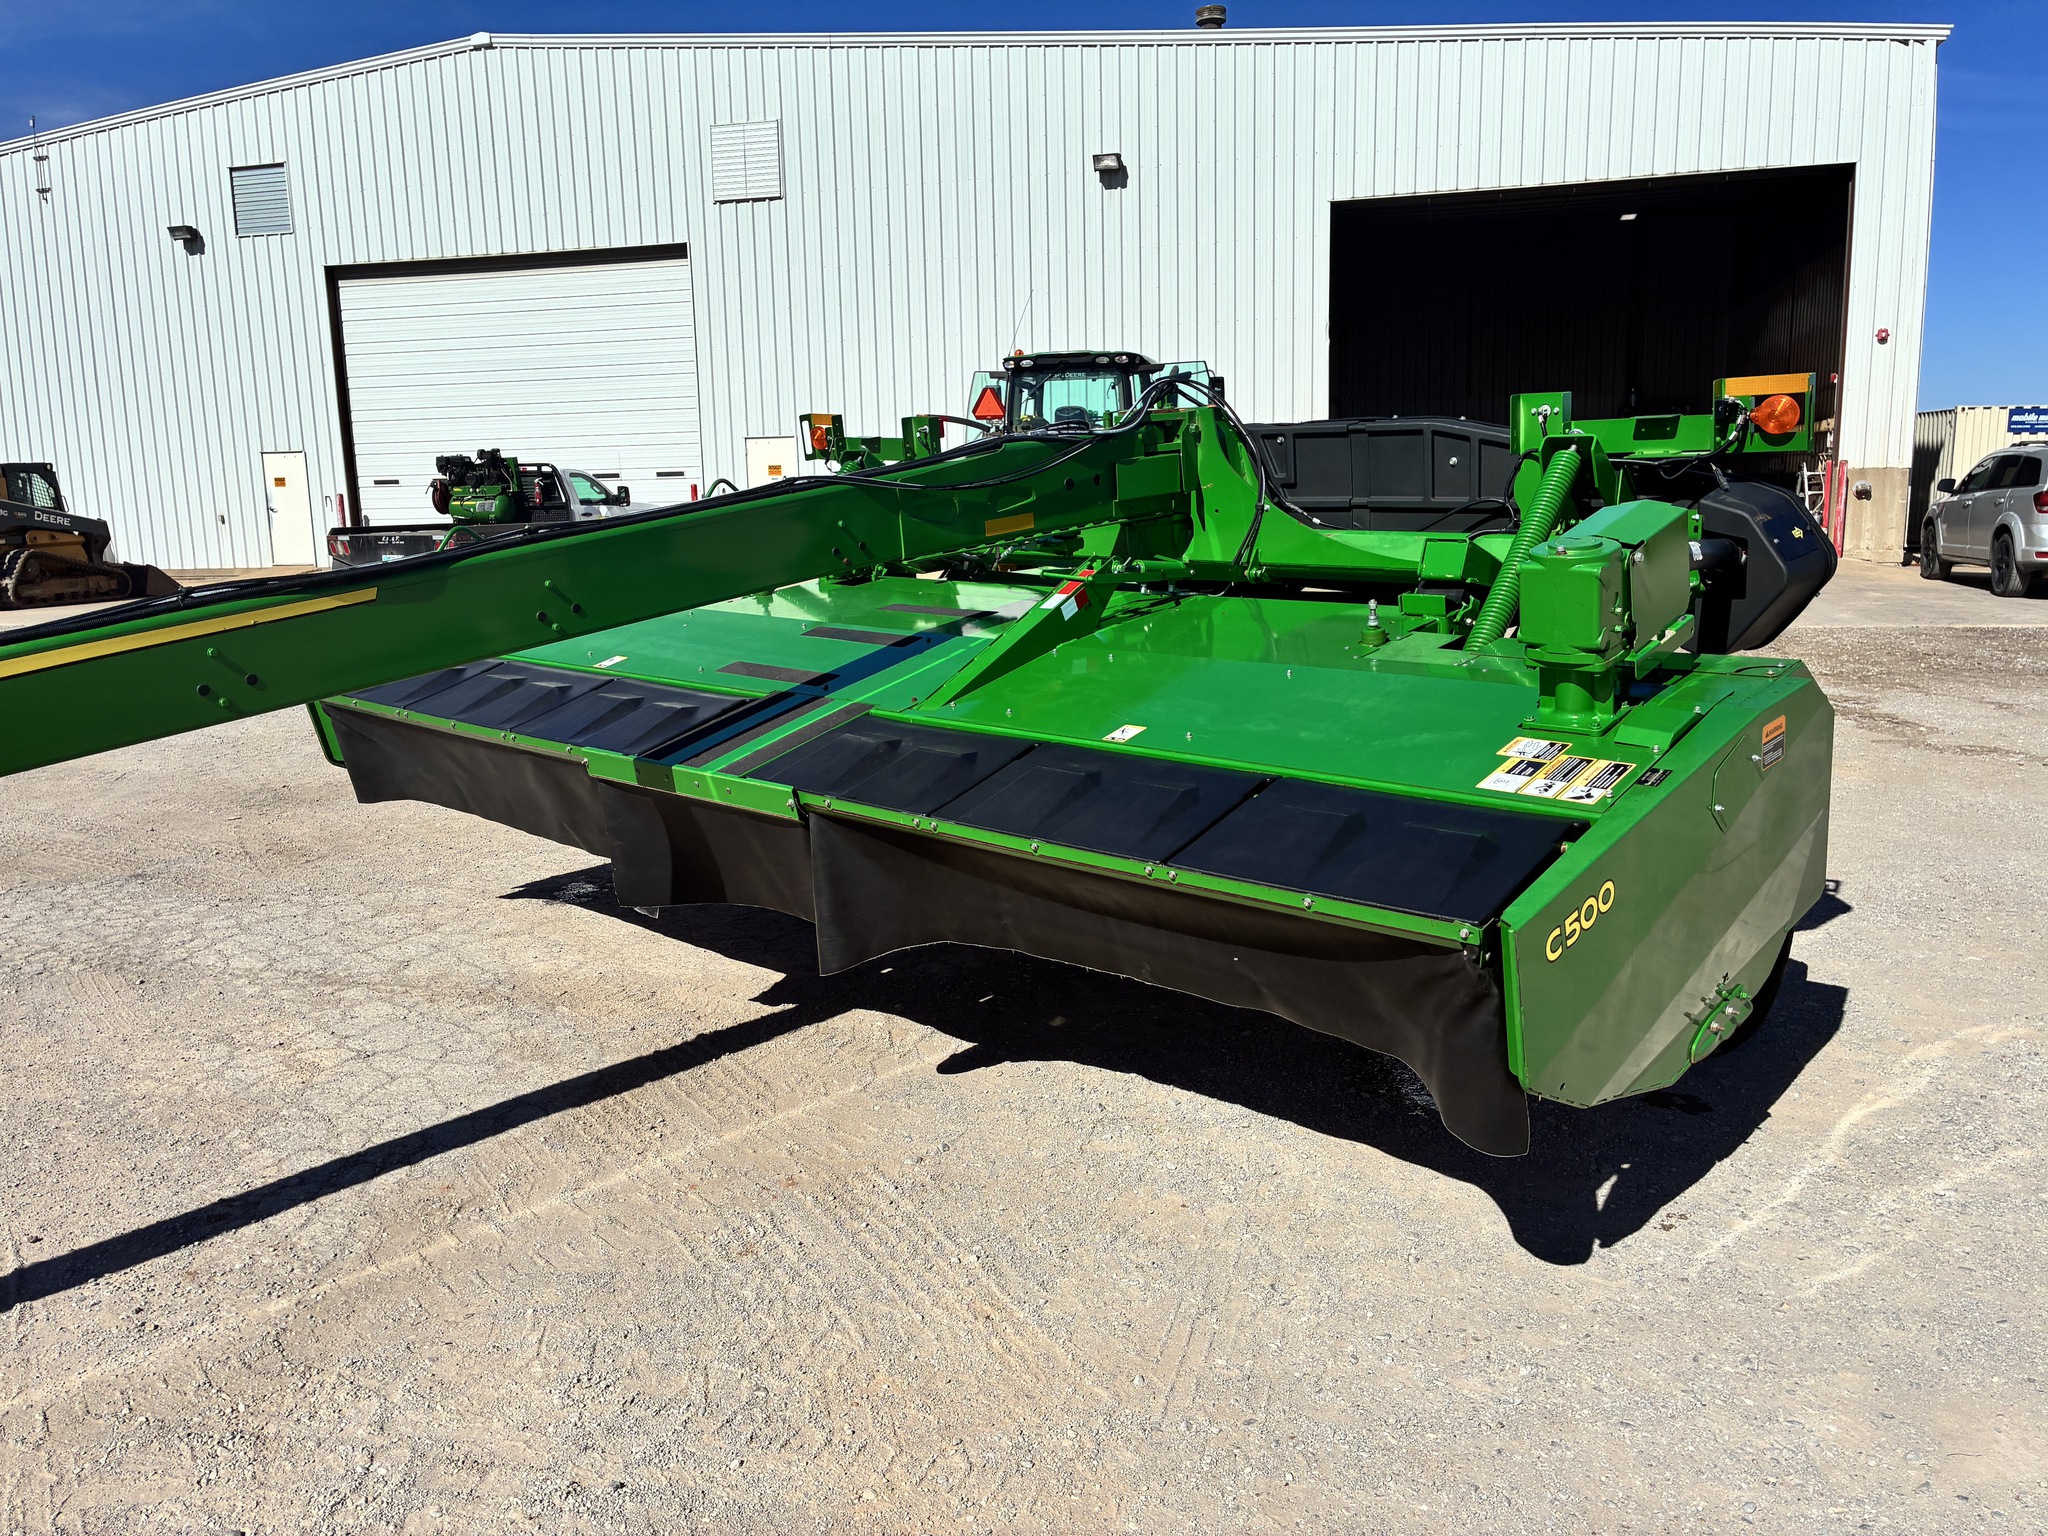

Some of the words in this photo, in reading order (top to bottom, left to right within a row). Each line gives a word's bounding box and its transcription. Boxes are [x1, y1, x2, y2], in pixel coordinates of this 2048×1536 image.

[2011, 412, 2038, 421] mobile
[34, 510, 71, 526] DEERE
[1545, 879, 1615, 963] C500
